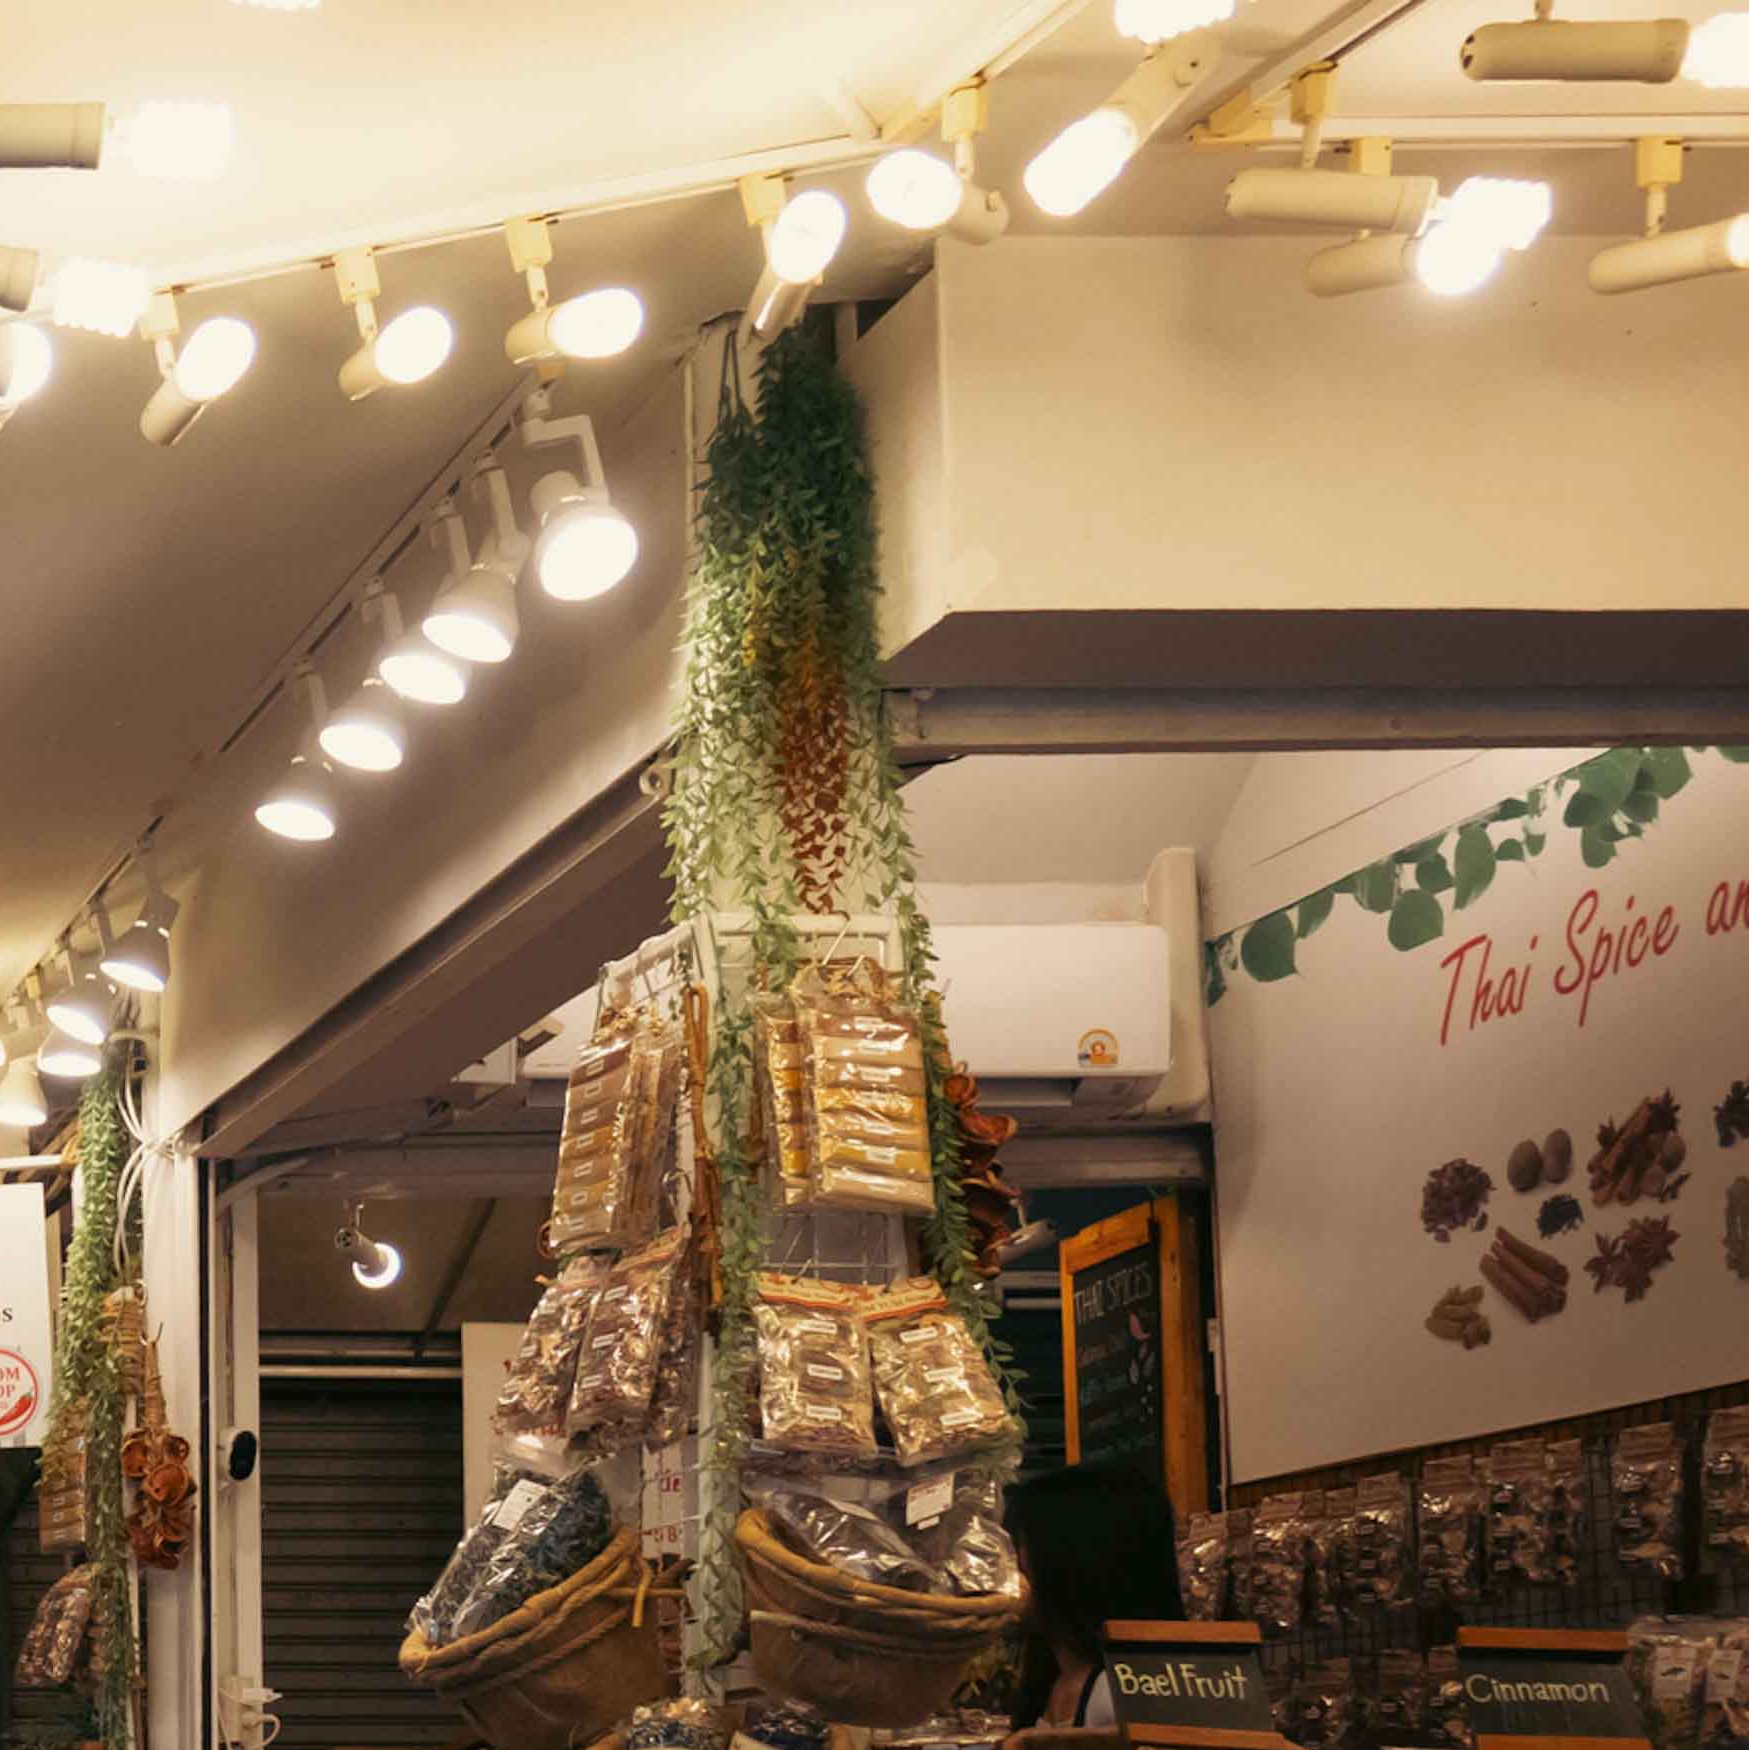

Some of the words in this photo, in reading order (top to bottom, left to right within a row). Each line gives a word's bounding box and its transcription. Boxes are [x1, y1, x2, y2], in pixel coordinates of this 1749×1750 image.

[1440, 934, 1540, 1046] Thai
[1554, 888, 1681, 1028] Spice
[1113, 1660, 1177, 1698] Bael
[1181, 1664, 1249, 1702] Fruit
[1465, 1672, 1611, 1704] Cinnamon
